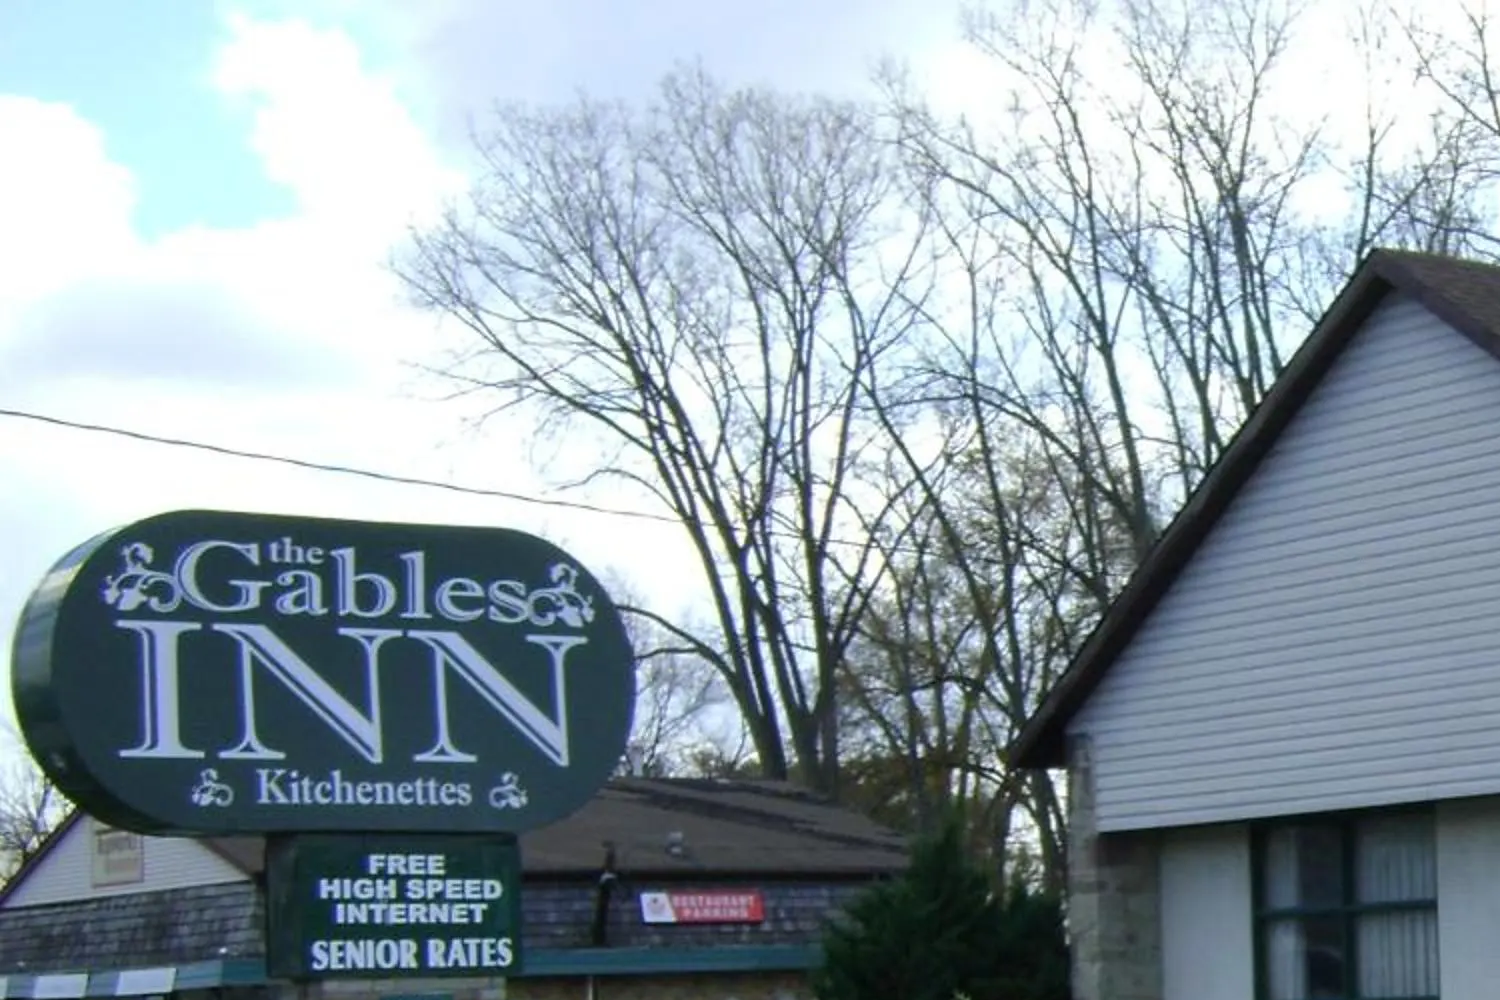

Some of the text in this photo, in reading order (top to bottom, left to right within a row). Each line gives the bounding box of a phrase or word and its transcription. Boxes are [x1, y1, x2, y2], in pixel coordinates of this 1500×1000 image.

[269, 537, 325, 565] the
[177, 539, 528, 624] Gables
[116, 619, 588, 767] INN
[256, 768, 473, 807] Kitchenettes
[367, 854, 447, 875] FREE
[318, 878, 503, 899] HIGH SPEED
[335, 903, 489, 923] INTERNET
[311, 938, 513, 970] SENIOR RATES
